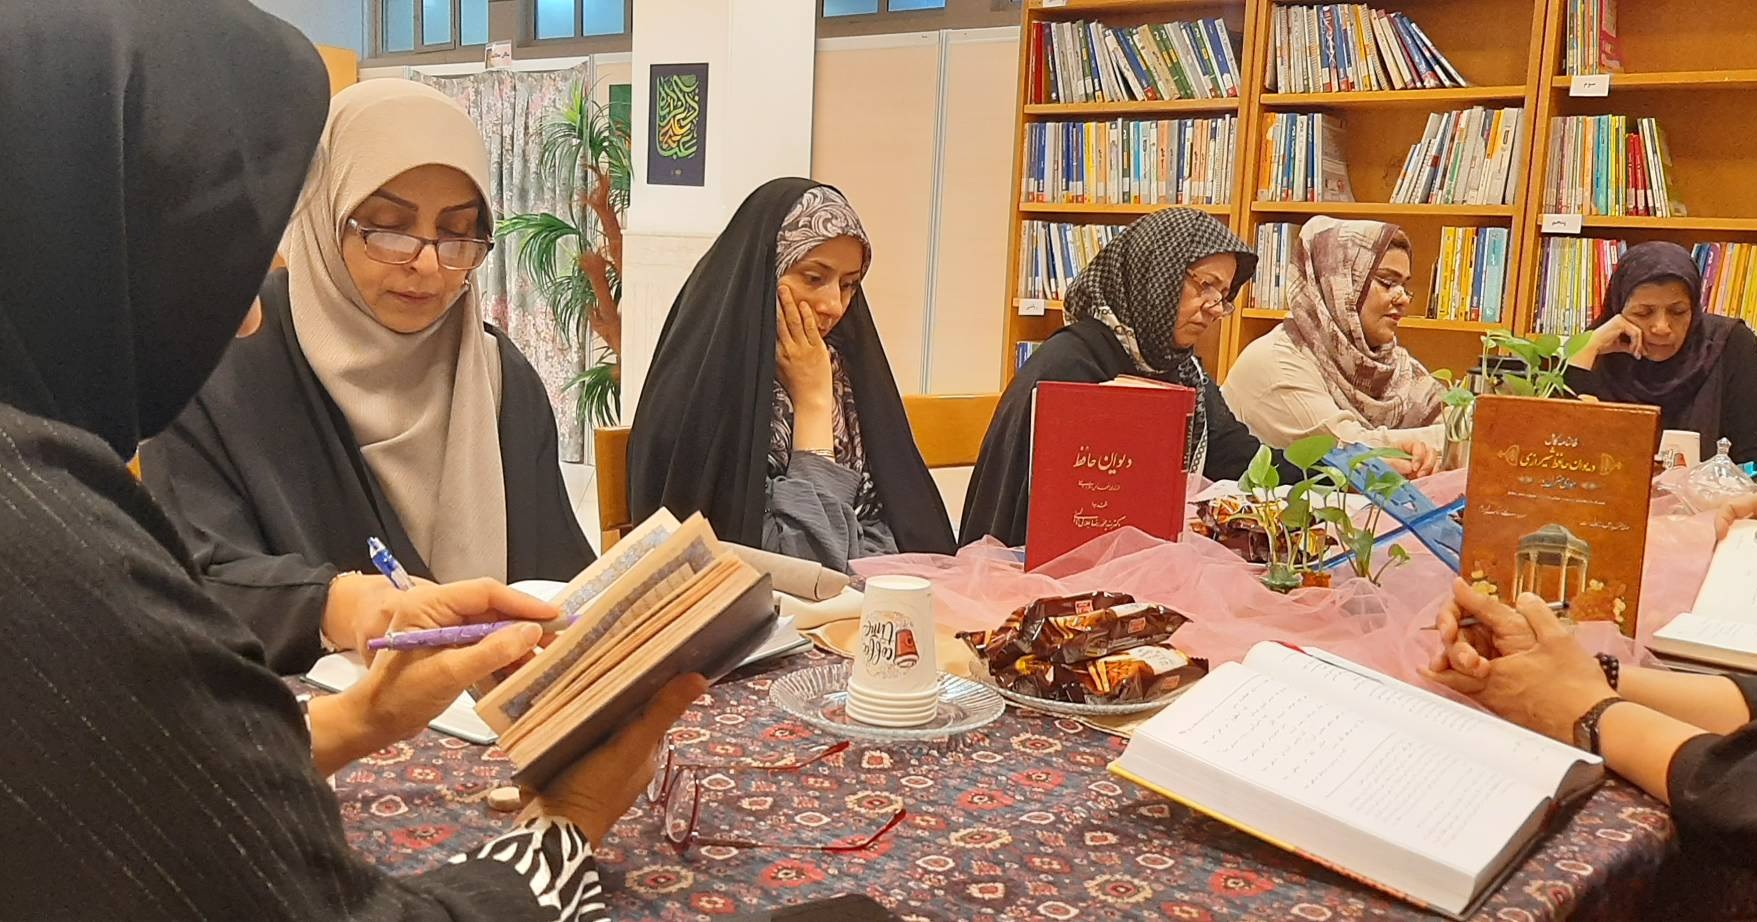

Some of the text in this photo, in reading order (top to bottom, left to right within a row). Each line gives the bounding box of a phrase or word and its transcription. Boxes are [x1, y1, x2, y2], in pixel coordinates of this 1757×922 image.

[1073, 446, 1133, 475] دیوان حافظ
[1519, 446, 1596, 472] دیوان حافظ شیرازی
